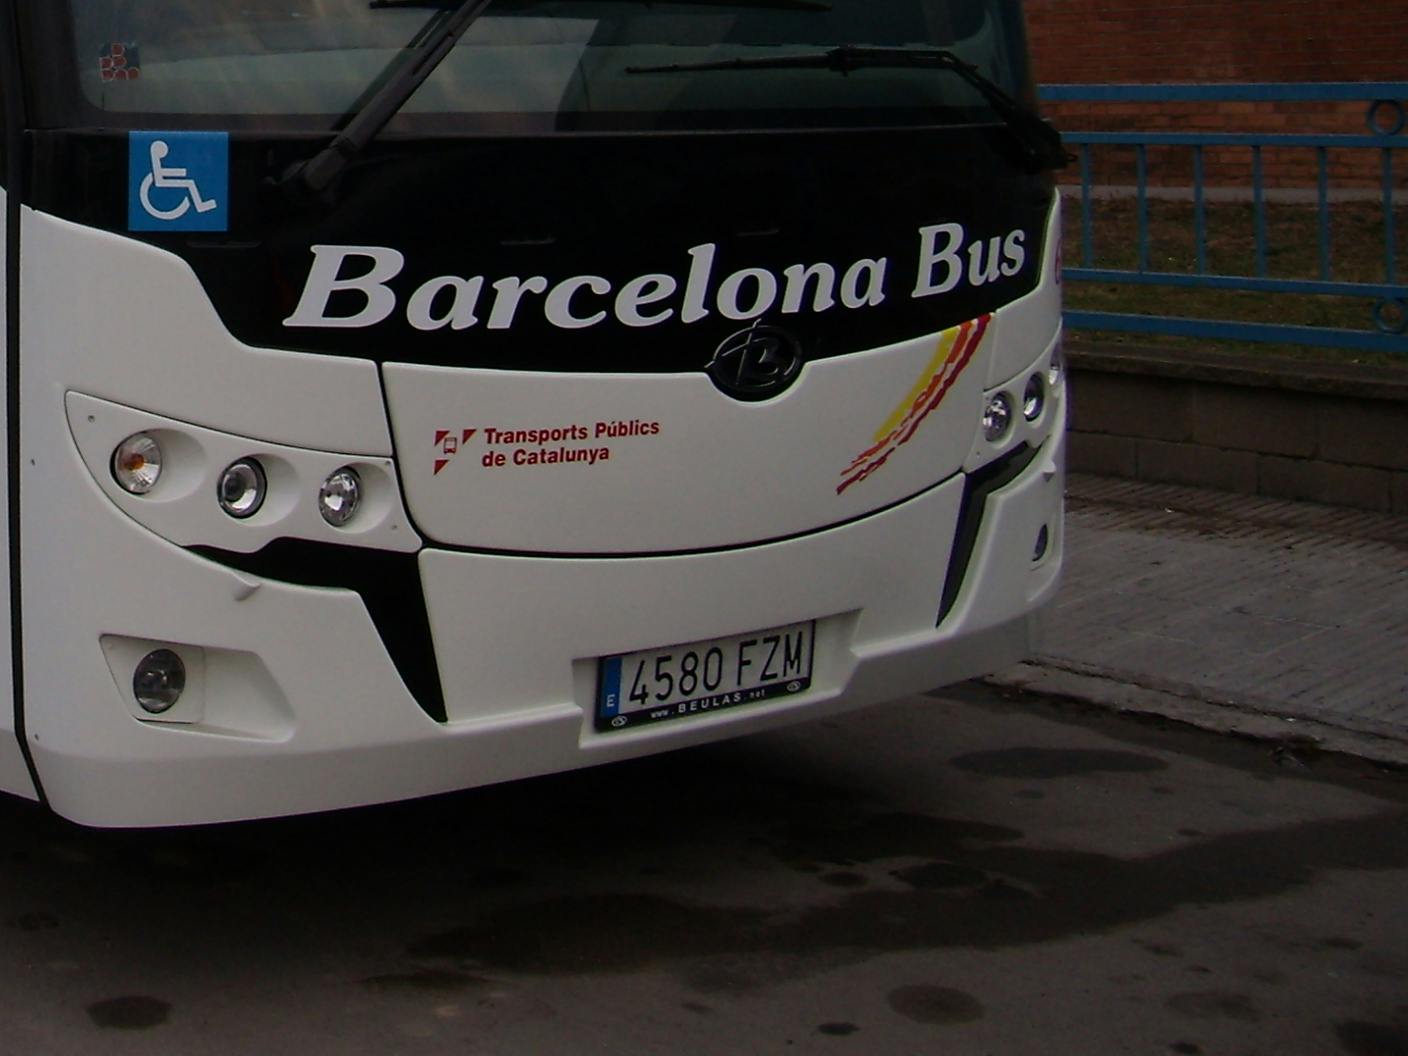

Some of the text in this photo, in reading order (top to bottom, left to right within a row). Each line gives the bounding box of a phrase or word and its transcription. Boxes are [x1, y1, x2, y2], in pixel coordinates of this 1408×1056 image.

[282, 243, 888, 330] Barcelona
[911, 222, 1026, 299] Bus
[484, 420, 659, 446] Transports Públics
[481, 446, 609, 467] de Catalunya
[628, 631, 803, 706] 4580 FZM
[606, 693, 616, 708] E
